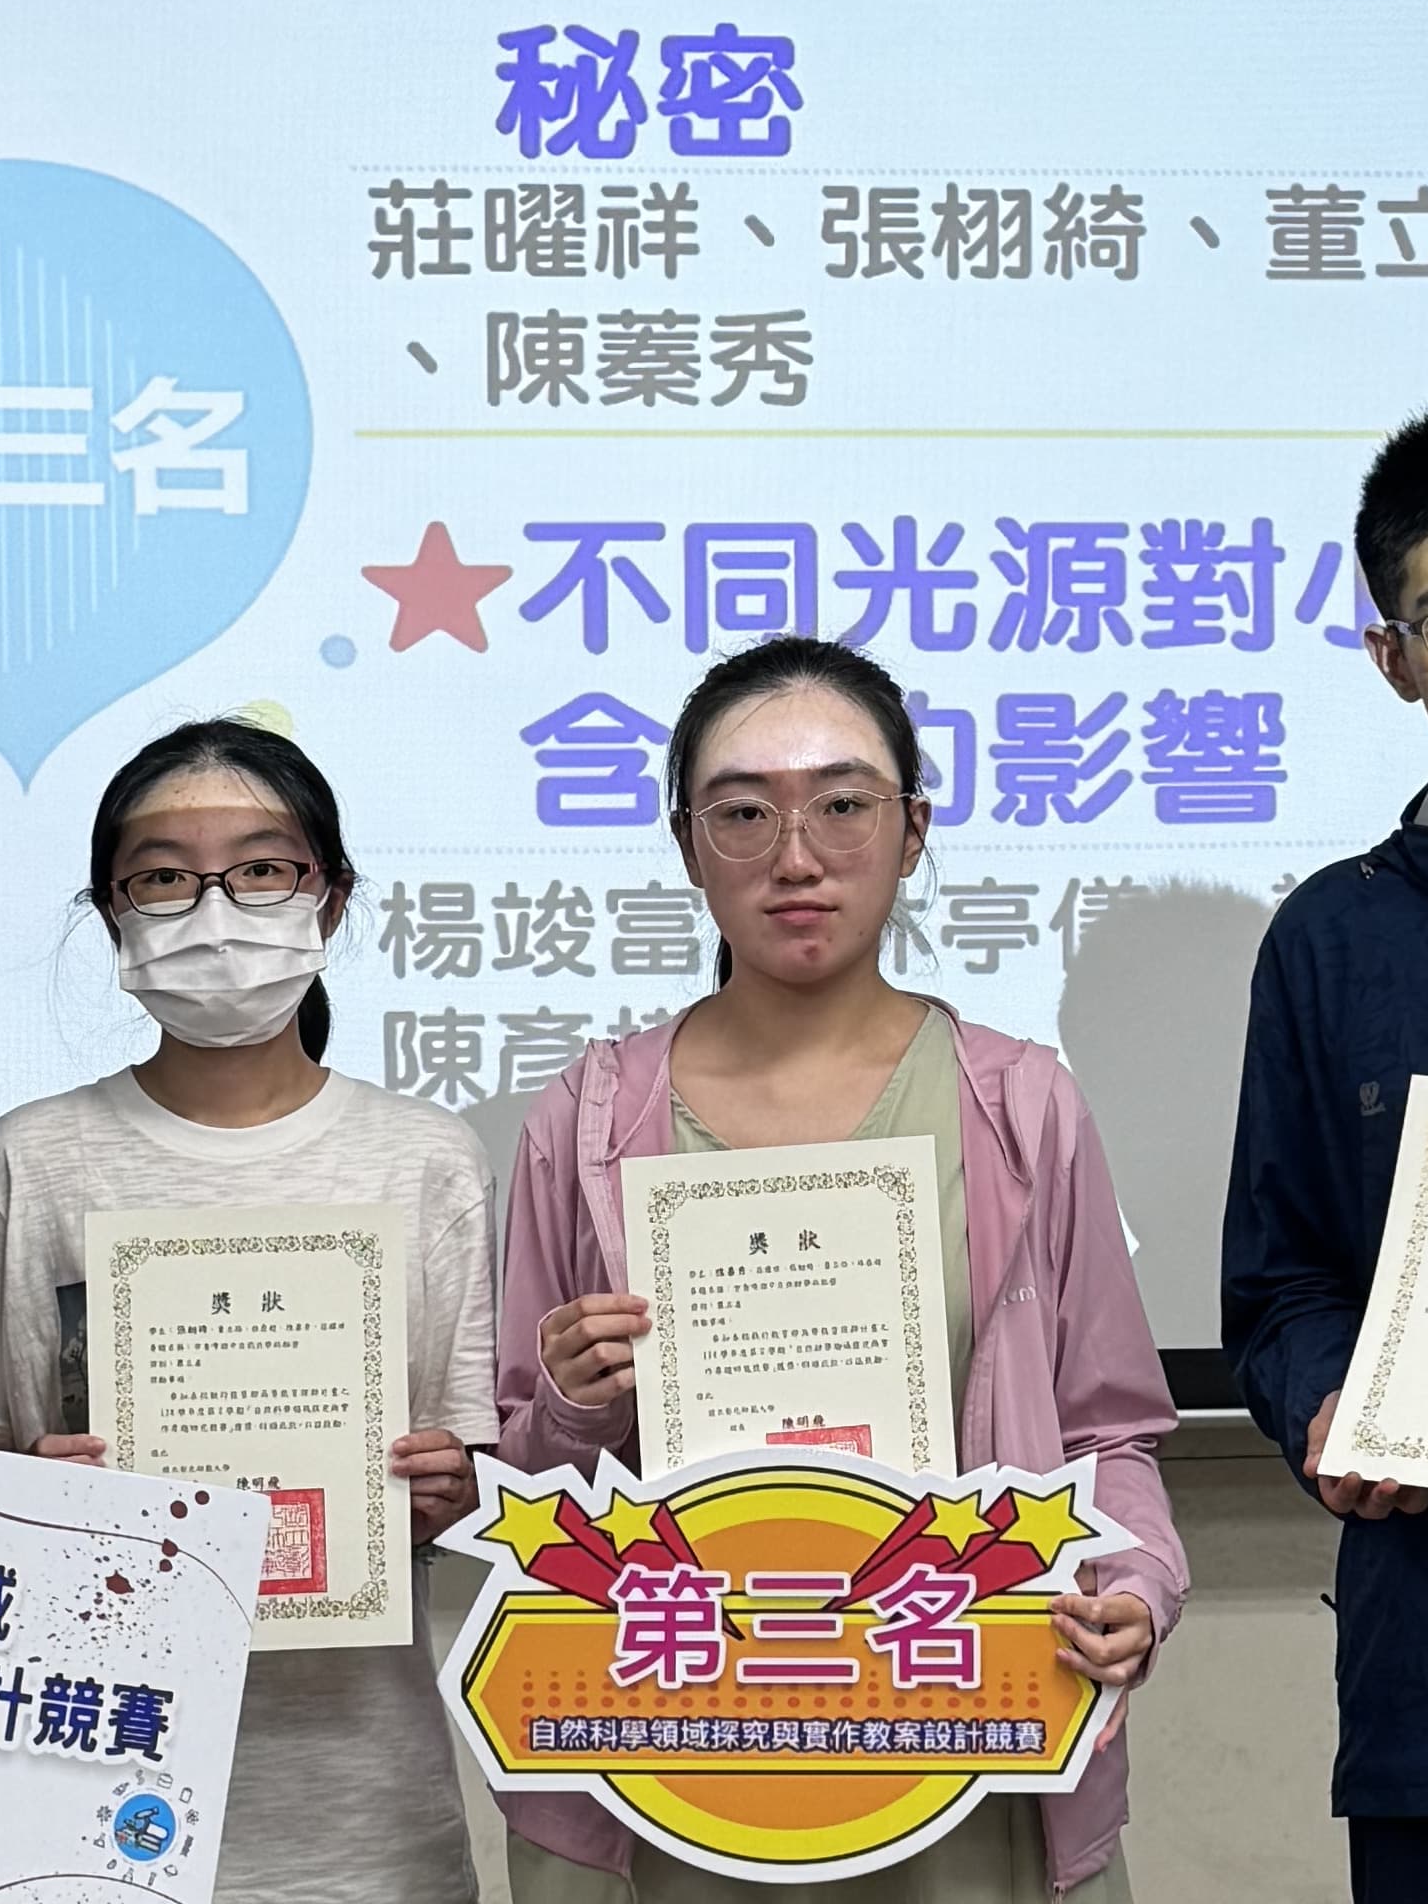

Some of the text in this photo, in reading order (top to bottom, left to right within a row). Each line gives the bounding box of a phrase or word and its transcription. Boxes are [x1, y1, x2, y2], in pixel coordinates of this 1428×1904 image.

[495, 22, 804, 159] 秘密
[520, 688, 1288, 828] 含的影響
[383, 1006, 682, 1106] 陳彥
[614, 1563, 978, 1684] 第三名
[529, 1717, 1045, 1753] 自然科學領域探究與實作教案設計競賽
